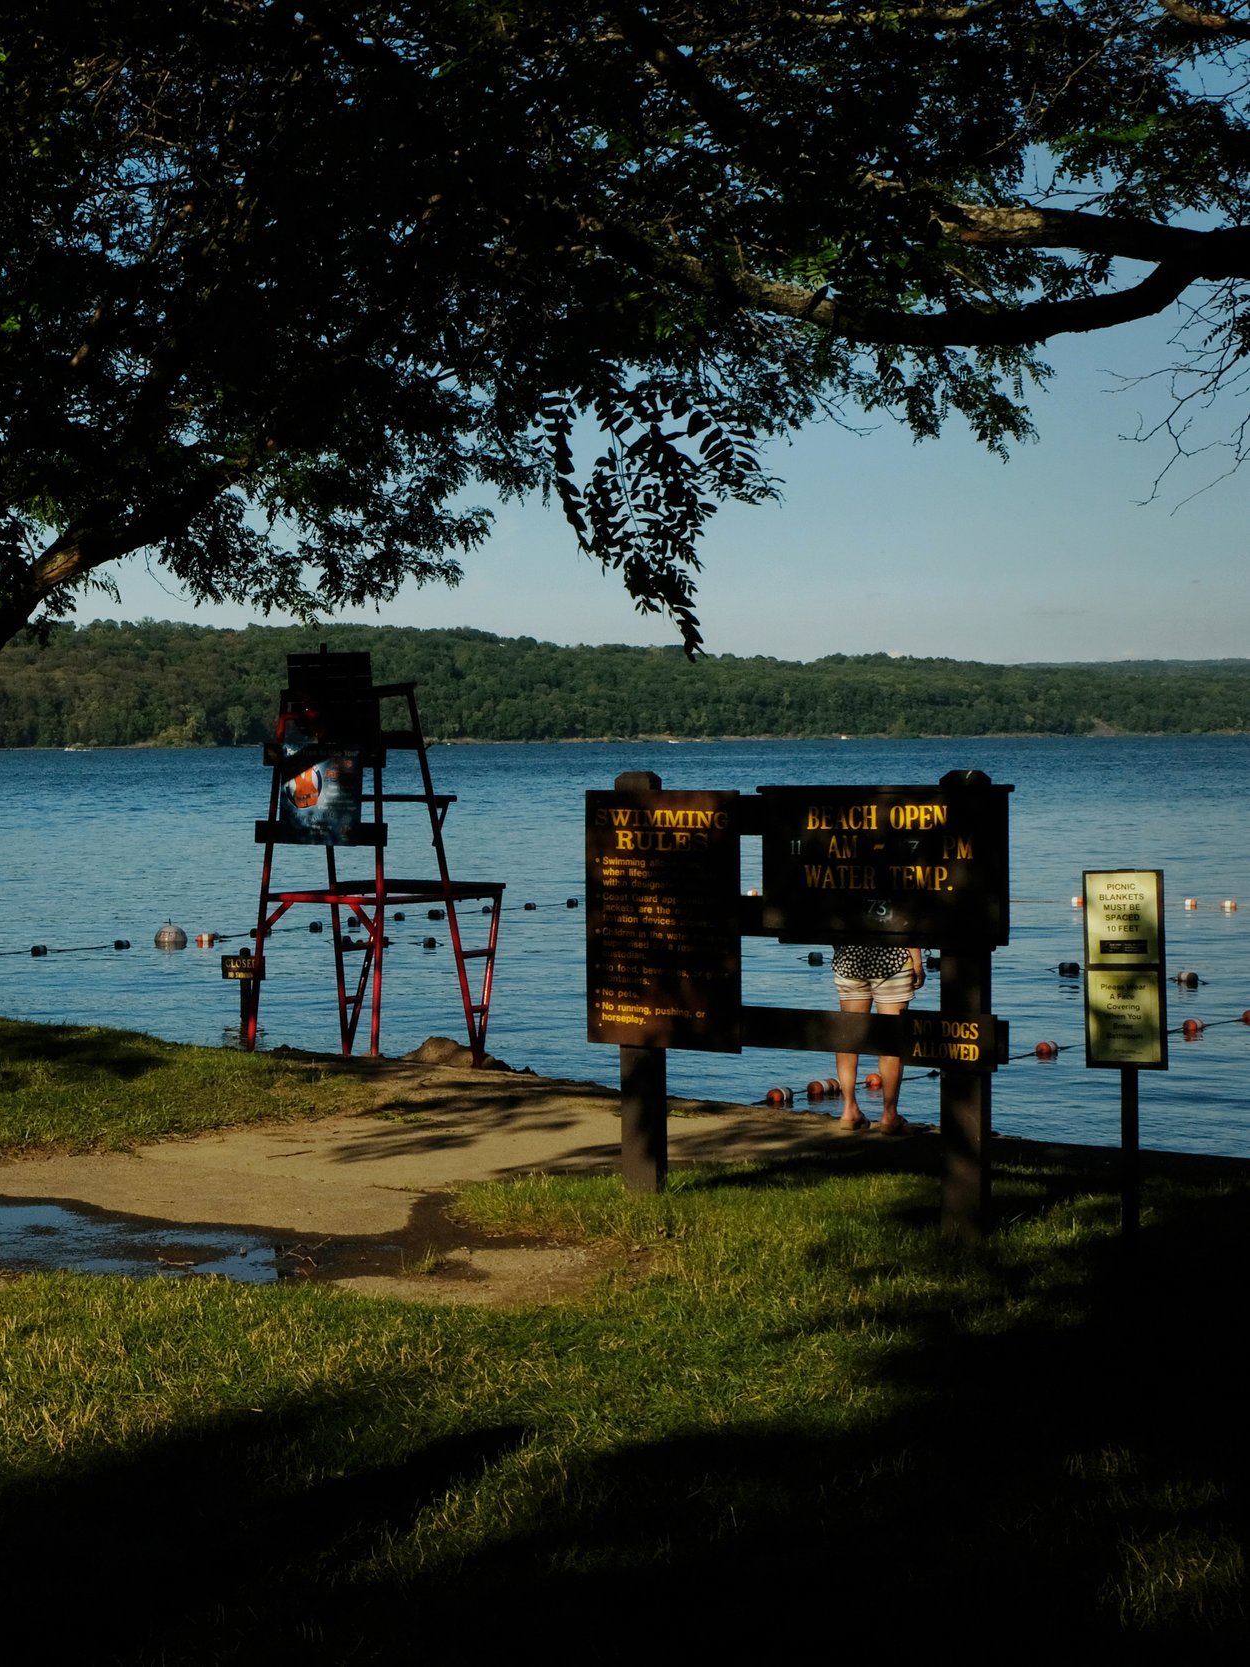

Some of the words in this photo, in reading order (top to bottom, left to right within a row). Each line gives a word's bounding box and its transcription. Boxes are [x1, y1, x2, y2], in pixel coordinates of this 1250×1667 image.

[595, 808, 729, 829] SWIMMING
[806, 805, 878, 830] BEACH
[889, 805, 949, 830] OPEN
[615, 830, 710, 851] RULES
[789, 839, 802, 856] 11
[828, 835, 859, 860] AM
[907, 840, 921, 854] 7
[941, 835, 975, 860] PM
[602, 856, 646, 867] Swimming
[602, 868, 626, 876] when
[803, 865, 877, 890] WATER
[889, 866, 954, 891] TEMP.
[1106, 883, 1136, 891] PICNIC
[602, 892, 628, 901] Coast
[631, 894, 658, 902] Guard
[1098, 893, 1145, 901] BLANKETS
[602, 904, 635, 912] jackets
[638, 906, 653, 914] are
[656, 906, 671, 914] the
[1103, 903, 1127, 911] MUST
[1129, 903, 1141, 911] BE
[1105, 913, 1140, 921] SPACED
[666, 931, 690, 940] wate
[1100, 983, 1125, 991] Please
[1126, 983, 1146, 991] Wear
[602, 987, 614, 997] No
[617, 989, 640, 999] pets.
[602, 1001, 615, 1011] No
[617, 1003, 652, 1015] running,
[655, 1006, 693, 1018] pushing,
[695, 1010, 707, 1018] or
[1106, 1003, 1141, 1012] Covering
[601, 1012, 647, 1025] horseplay.
[1104, 1012, 1126, 1020] When
[912, 1019, 932, 1037] NO
[941, 1020, 979, 1040] DOGS
[1112, 1022, 1133, 1030] Enter
[912, 1040, 980, 1062] ALLOWED
